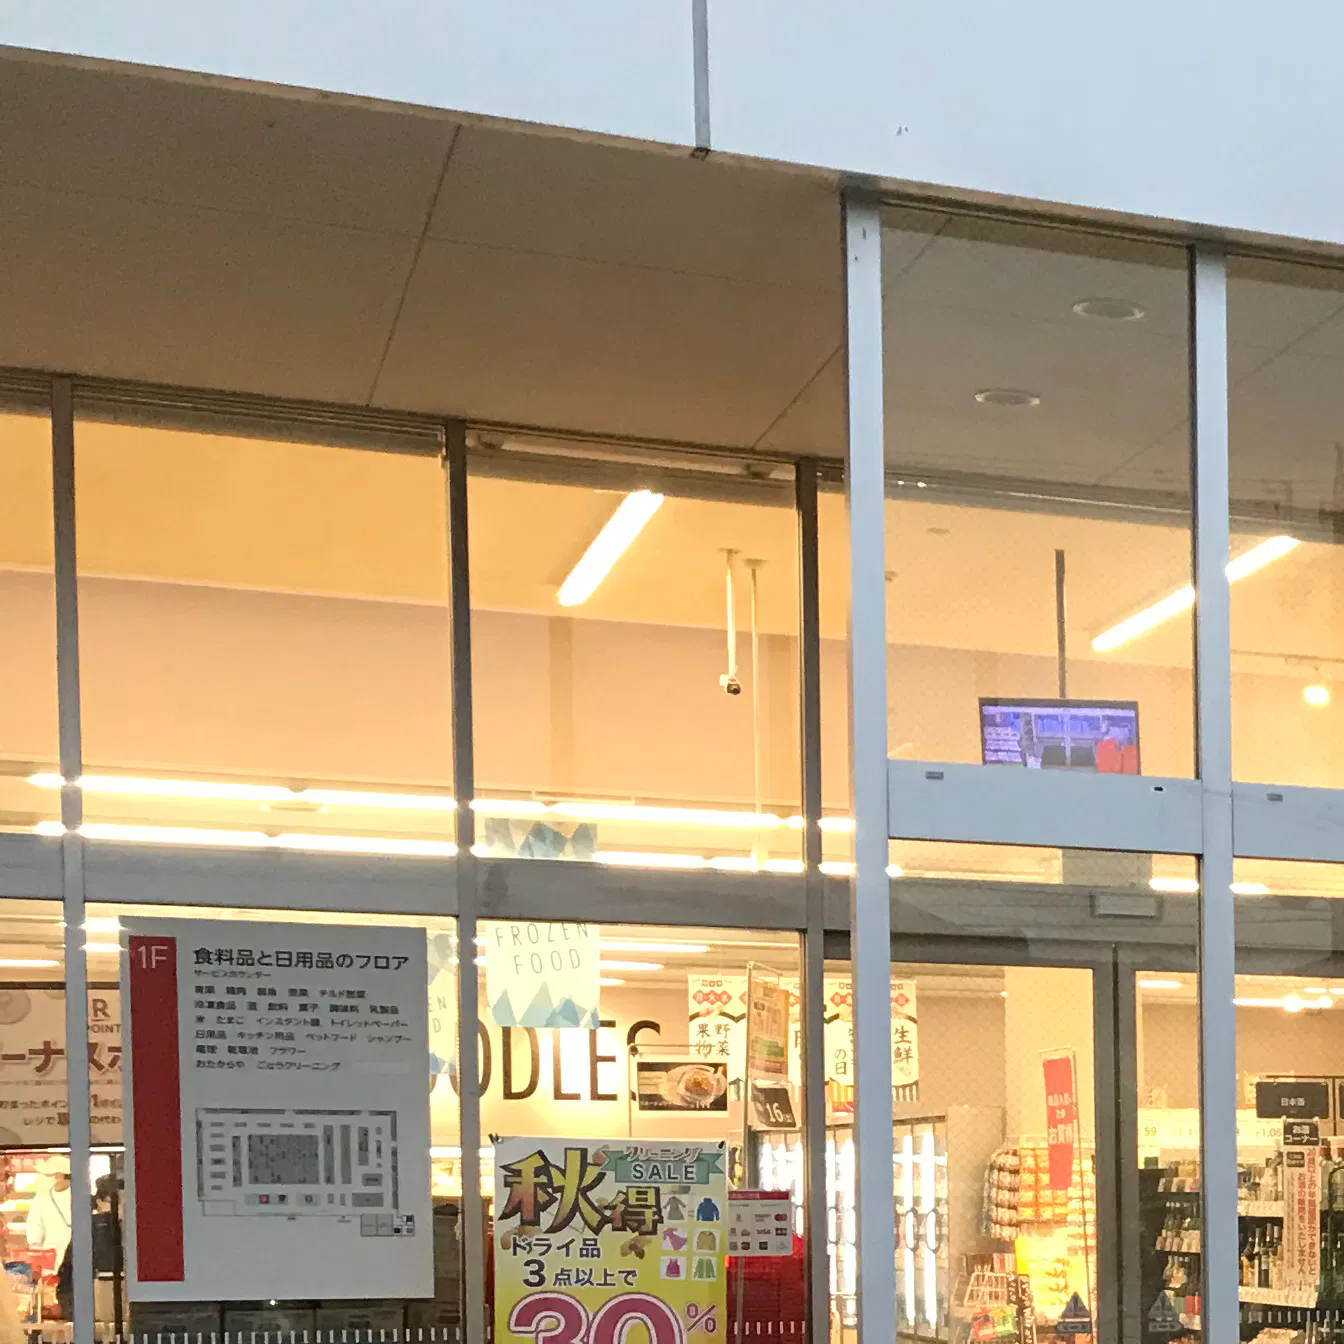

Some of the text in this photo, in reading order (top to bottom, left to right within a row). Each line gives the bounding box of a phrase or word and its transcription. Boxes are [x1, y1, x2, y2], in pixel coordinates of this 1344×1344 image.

[496, 921, 590, 947] FROZEN
[138, 945, 168, 969] 1F
[193, 947, 410, 971] 食料品と日用品のフロア
[514, 948, 581, 975] FOOD
[632, 1164, 696, 1181] SALE
[511, 1237, 602, 1259] ドライ品
[522, 1259, 638, 1288] 3点以上で
